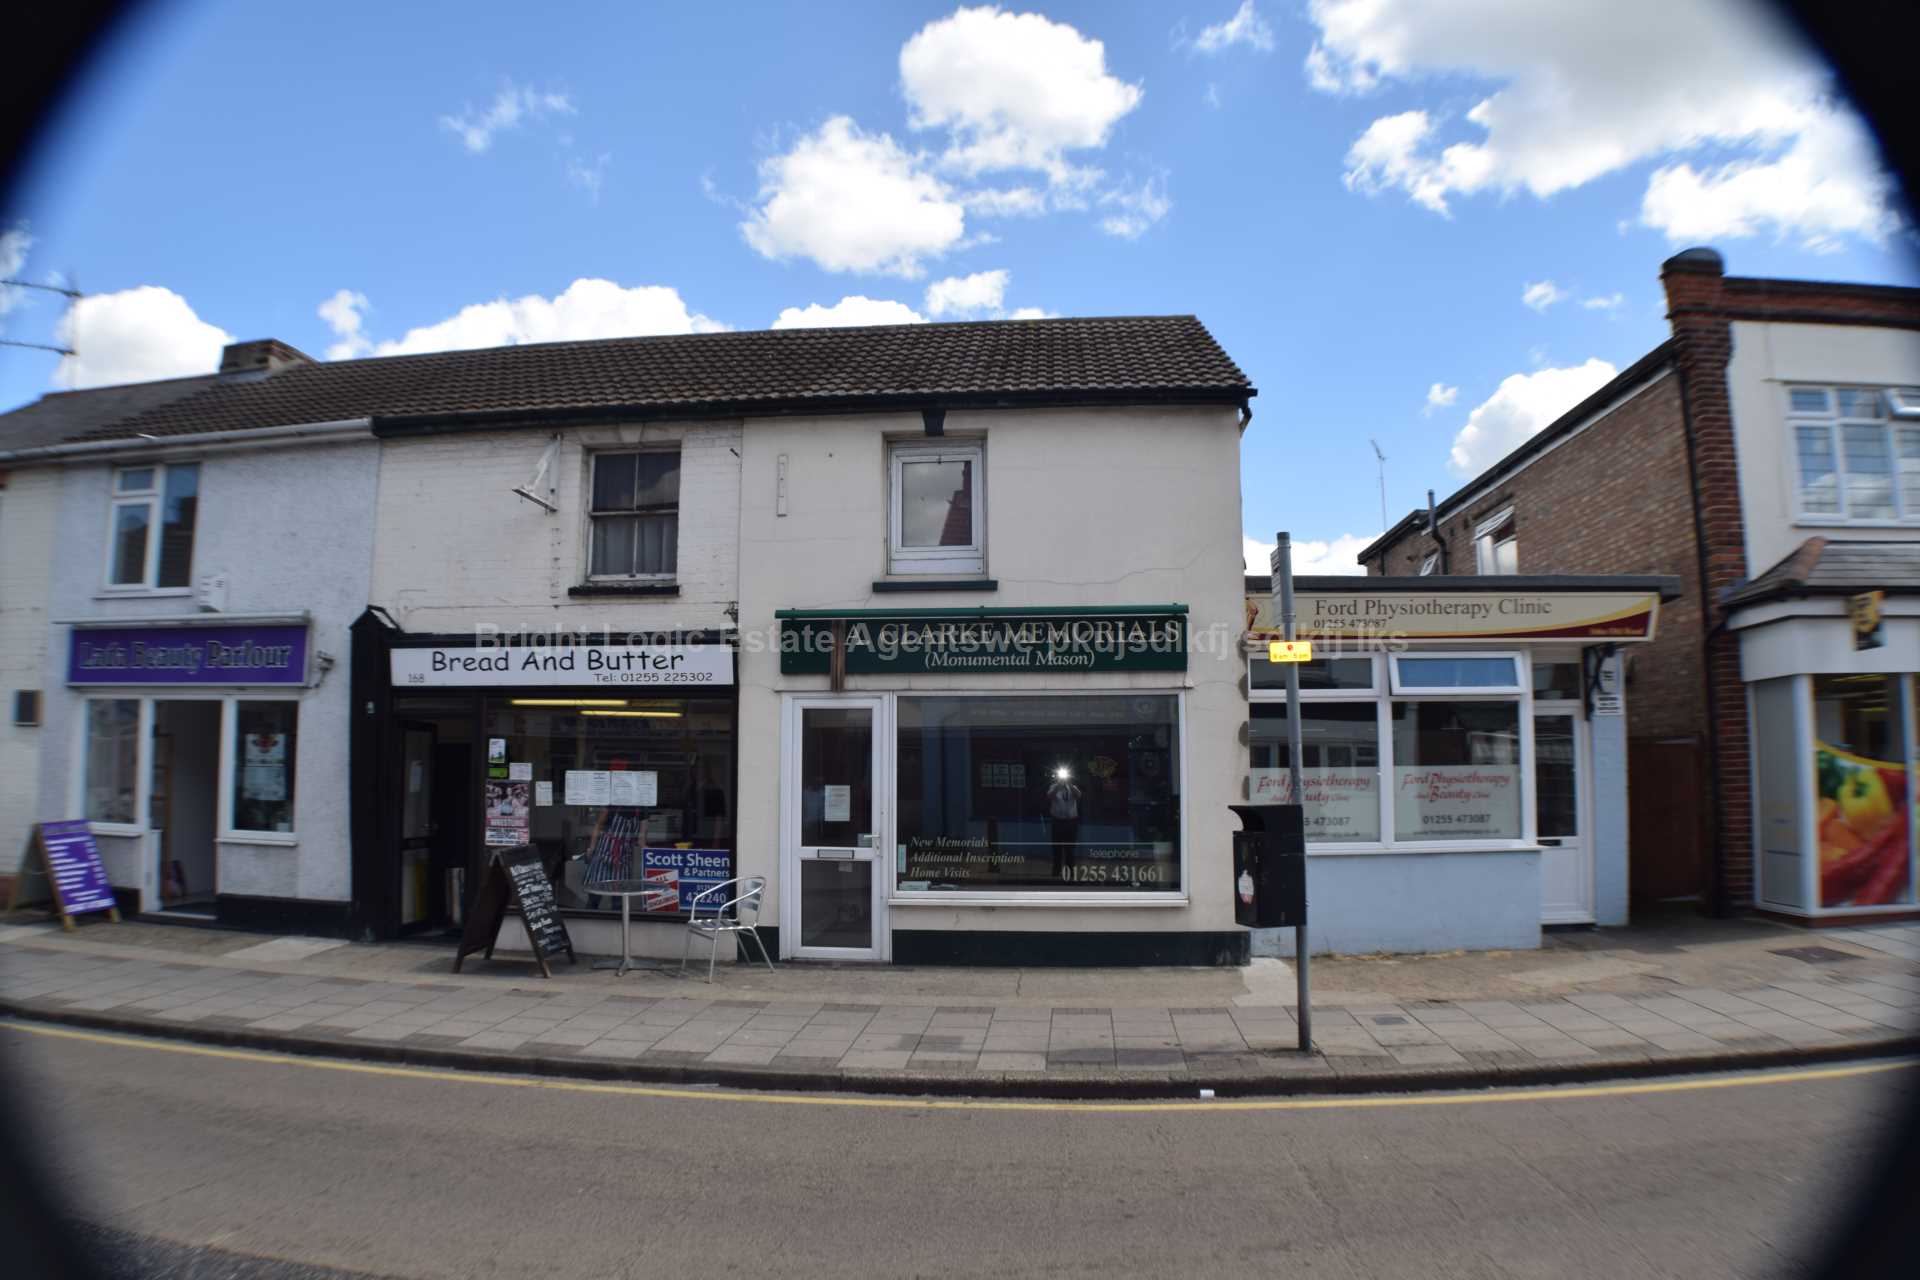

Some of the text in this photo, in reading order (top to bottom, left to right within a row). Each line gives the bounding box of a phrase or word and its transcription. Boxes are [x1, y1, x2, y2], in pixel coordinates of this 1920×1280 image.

[1314, 599, 1553, 619] Ford Physiotherapy Clinic
[1314, 619, 1345, 629] 01255
[846, 620, 1180, 645] A CLARKE MEMORIALS
[431, 649, 684, 672] Bread And Butter
[924, 650, 1096, 669] (Monumental Mason)
[594, 672, 713, 683] Tel: 01255 225302
[910, 836, 990, 848] New Memorials
[645, 852, 730, 867] Scott Sheen
[909, 851, 1025, 865] Additional Inscriptions
[684, 867, 730, 878] & Partners
[909, 866, 971, 878] Home Visits
[1062, 865, 1165, 882] 01255 431661
